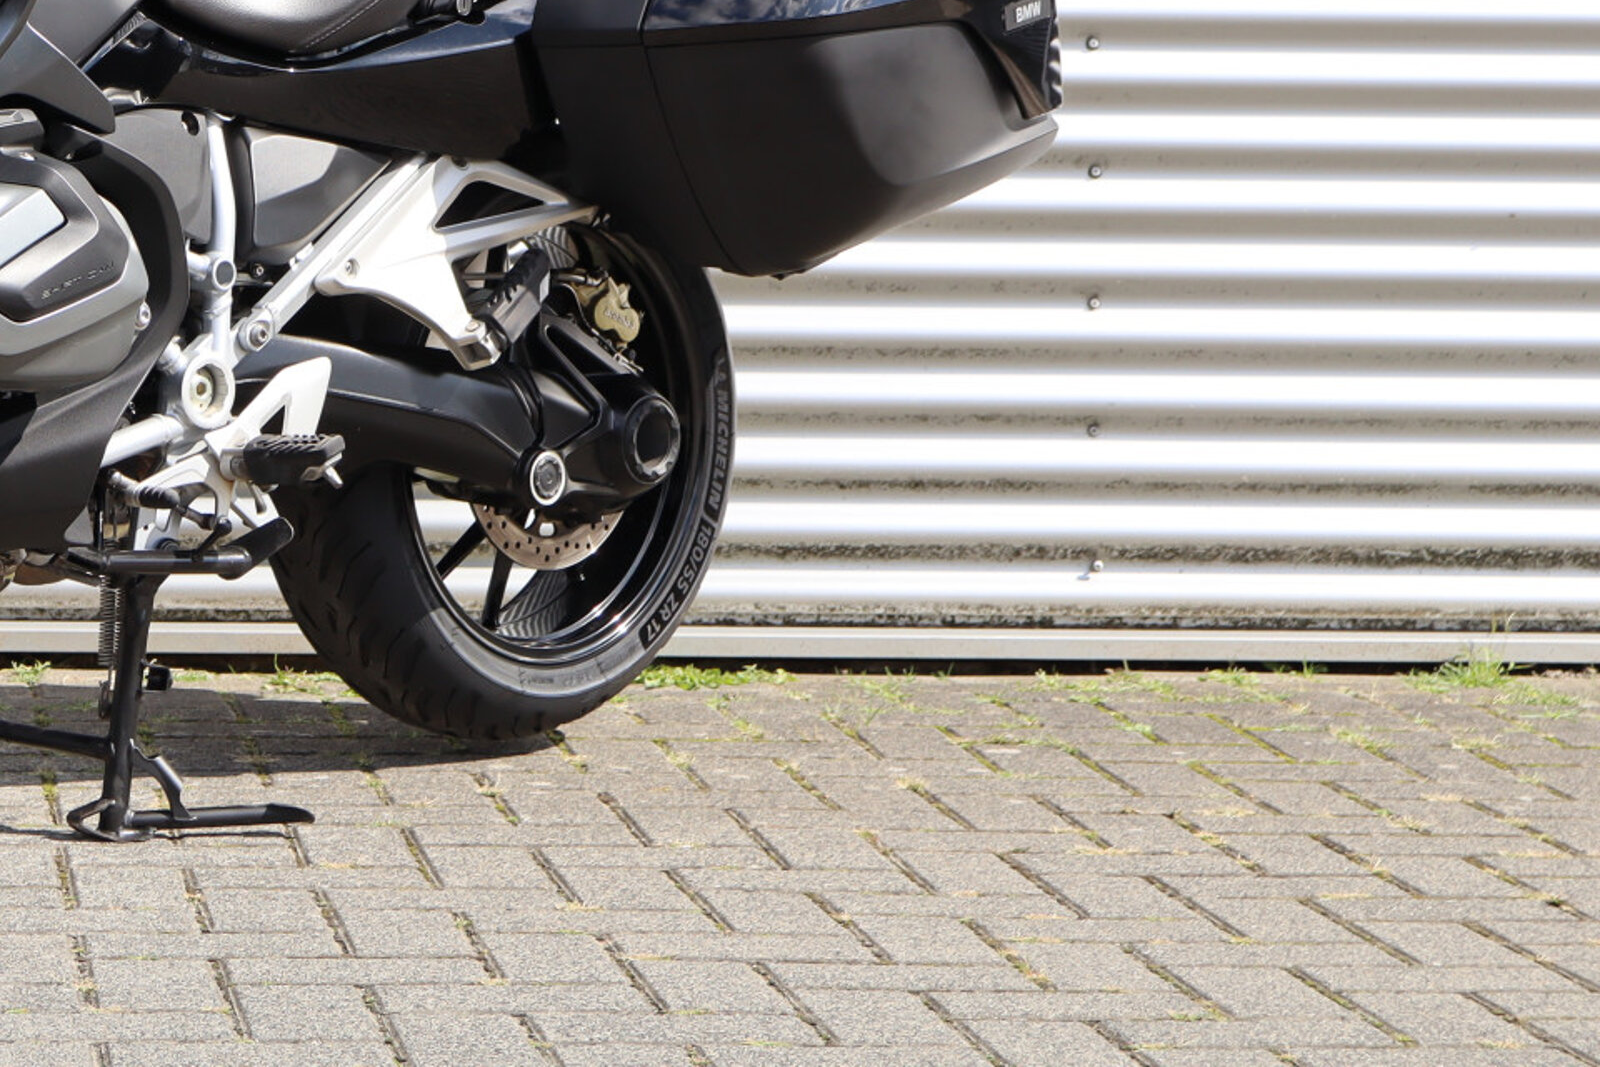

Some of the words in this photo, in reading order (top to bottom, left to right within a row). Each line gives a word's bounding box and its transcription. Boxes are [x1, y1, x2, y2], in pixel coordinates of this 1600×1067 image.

[1016, 0, 1041, 23] BMW
[707, 388, 730, 510] MICHELIN
[677, 524, 713, 595] 180/55
[658, 600, 680, 623] ZR
[645, 619, 663, 642] 17
